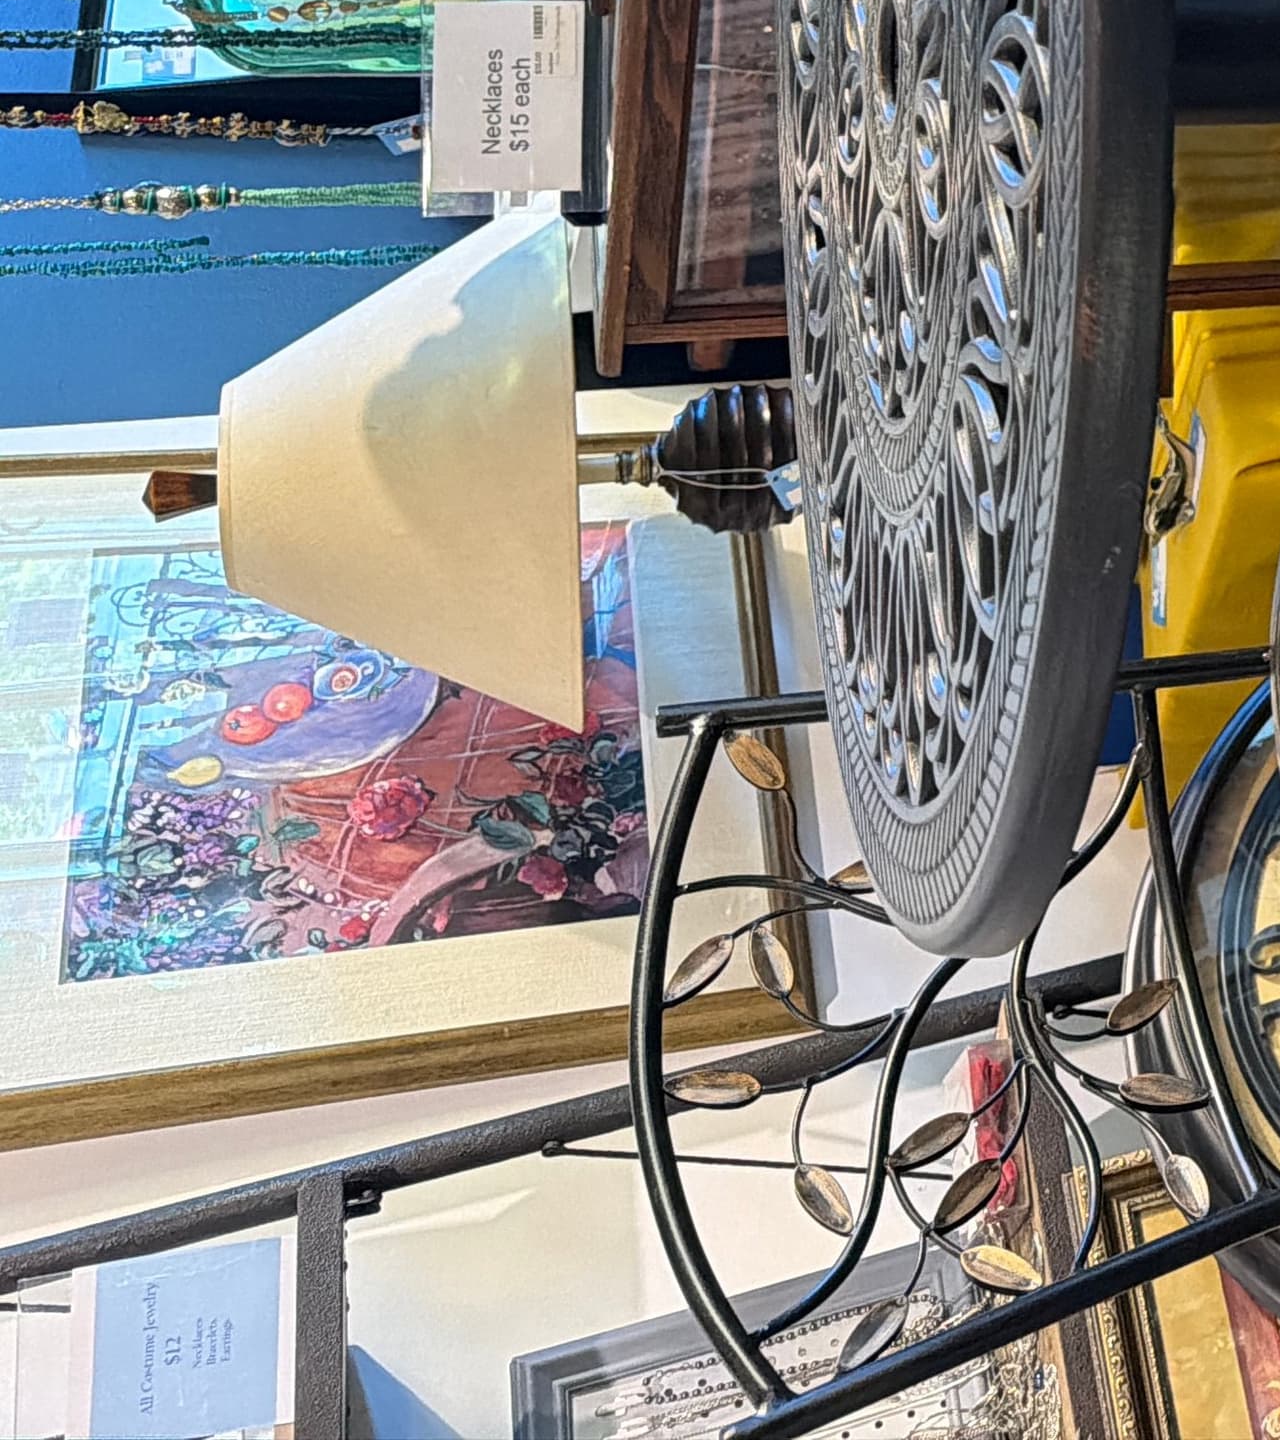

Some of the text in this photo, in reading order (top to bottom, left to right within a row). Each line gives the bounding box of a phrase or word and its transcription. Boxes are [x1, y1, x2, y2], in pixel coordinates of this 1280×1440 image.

[481, 48, 503, 155] Necklaces
[509, 57, 531, 152] $15 each
[140, 1281, 159, 1413] All Costume Jewelry
[164, 1336, 182, 1366] $12
